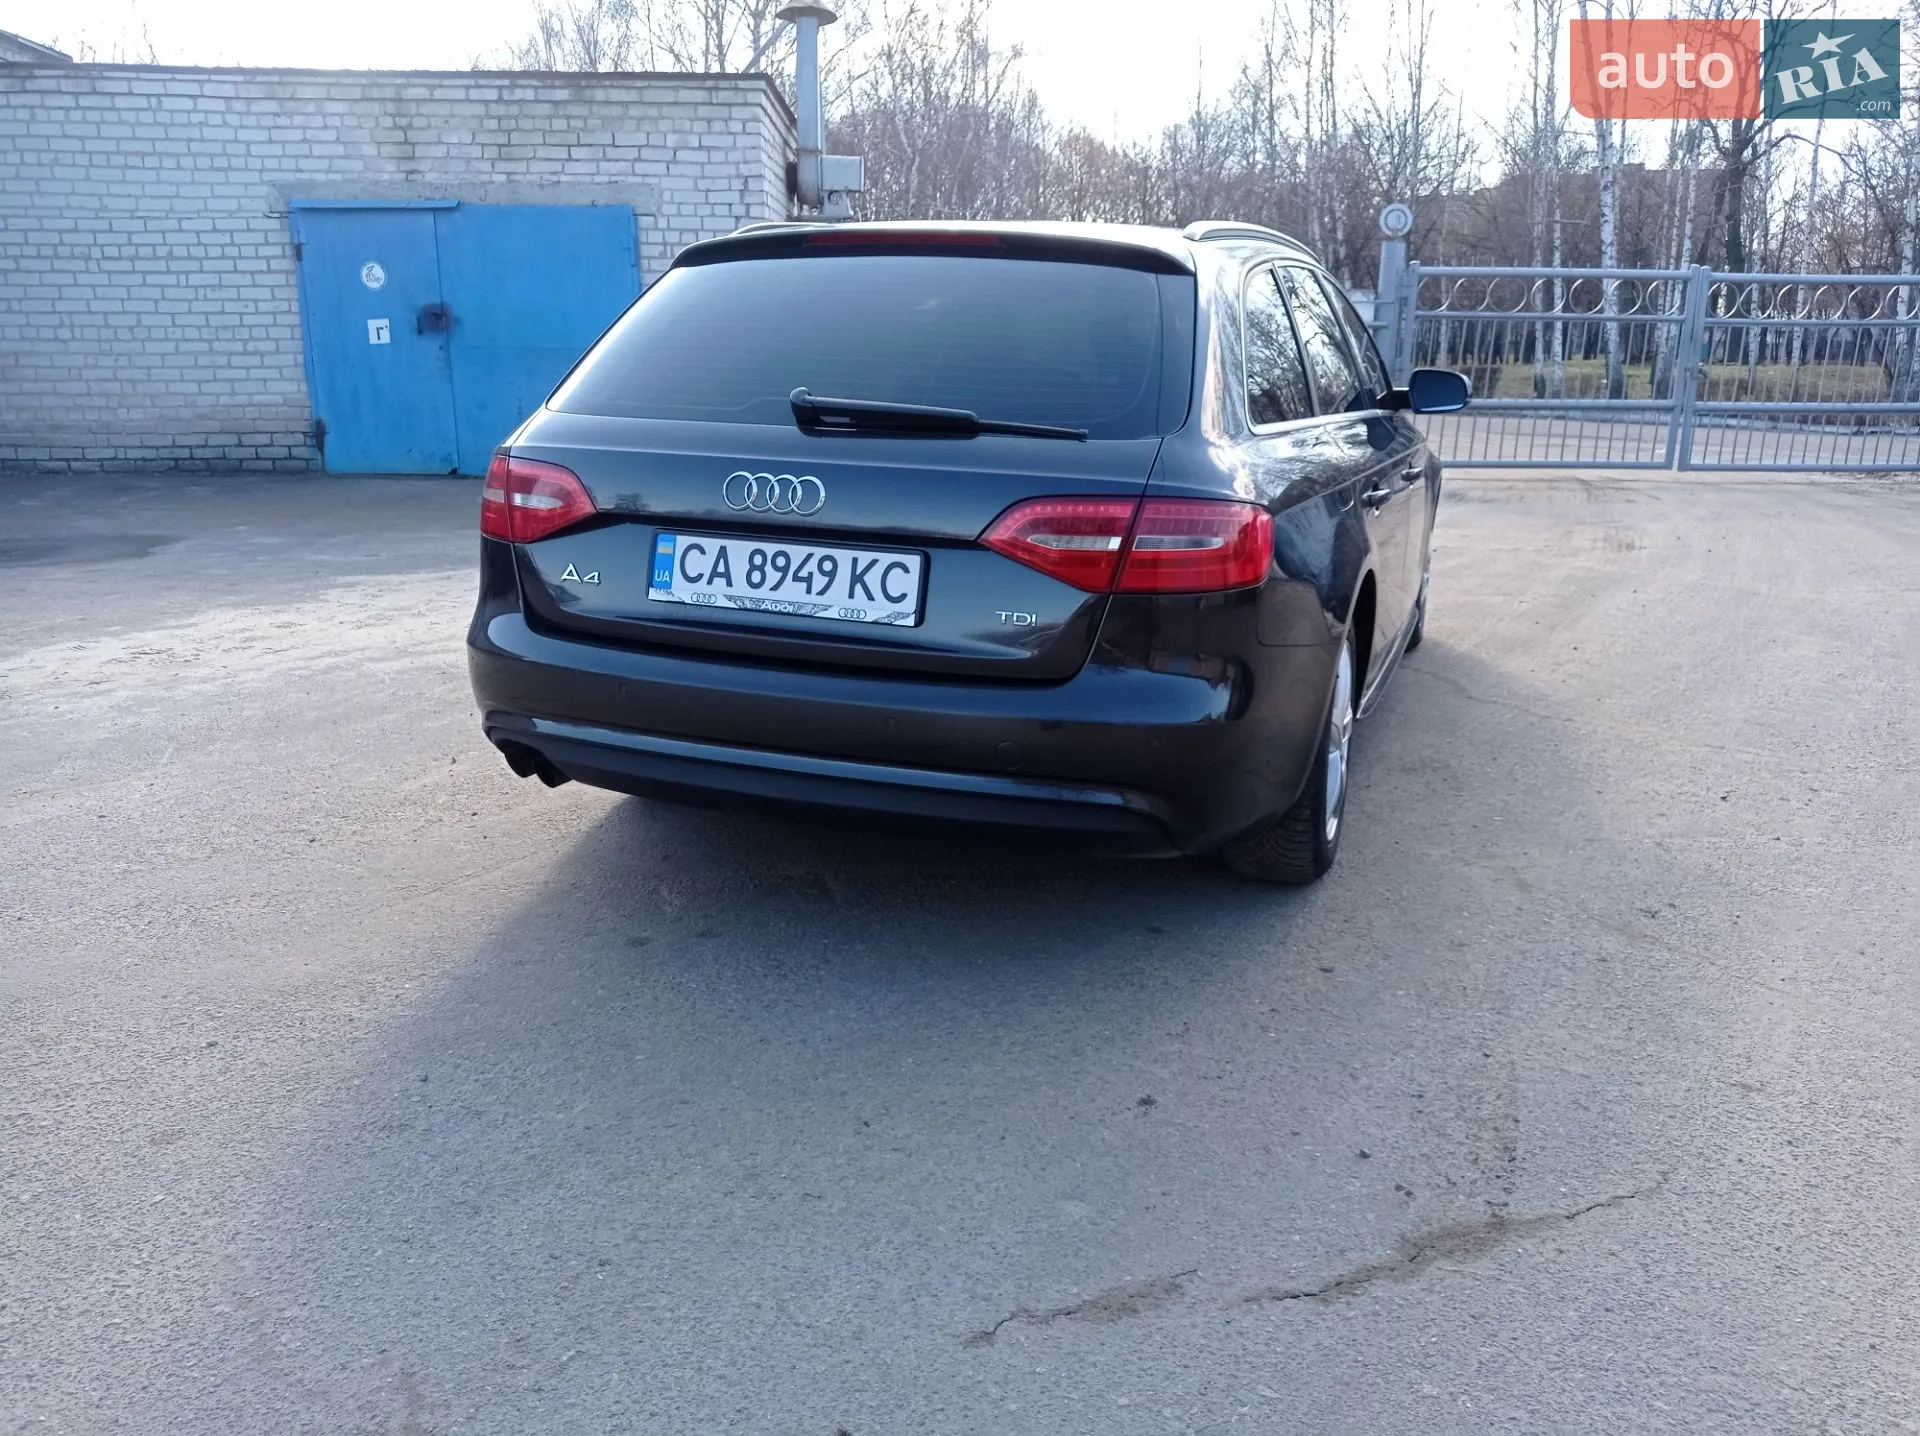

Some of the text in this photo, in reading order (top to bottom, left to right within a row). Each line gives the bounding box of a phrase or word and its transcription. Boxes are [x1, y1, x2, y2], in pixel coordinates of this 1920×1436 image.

[561, 563, 600, 585] A4
[655, 569, 670, 582] UA
[680, 543, 910, 603] CA 8949 KC
[996, 611, 1036, 626] TDI
